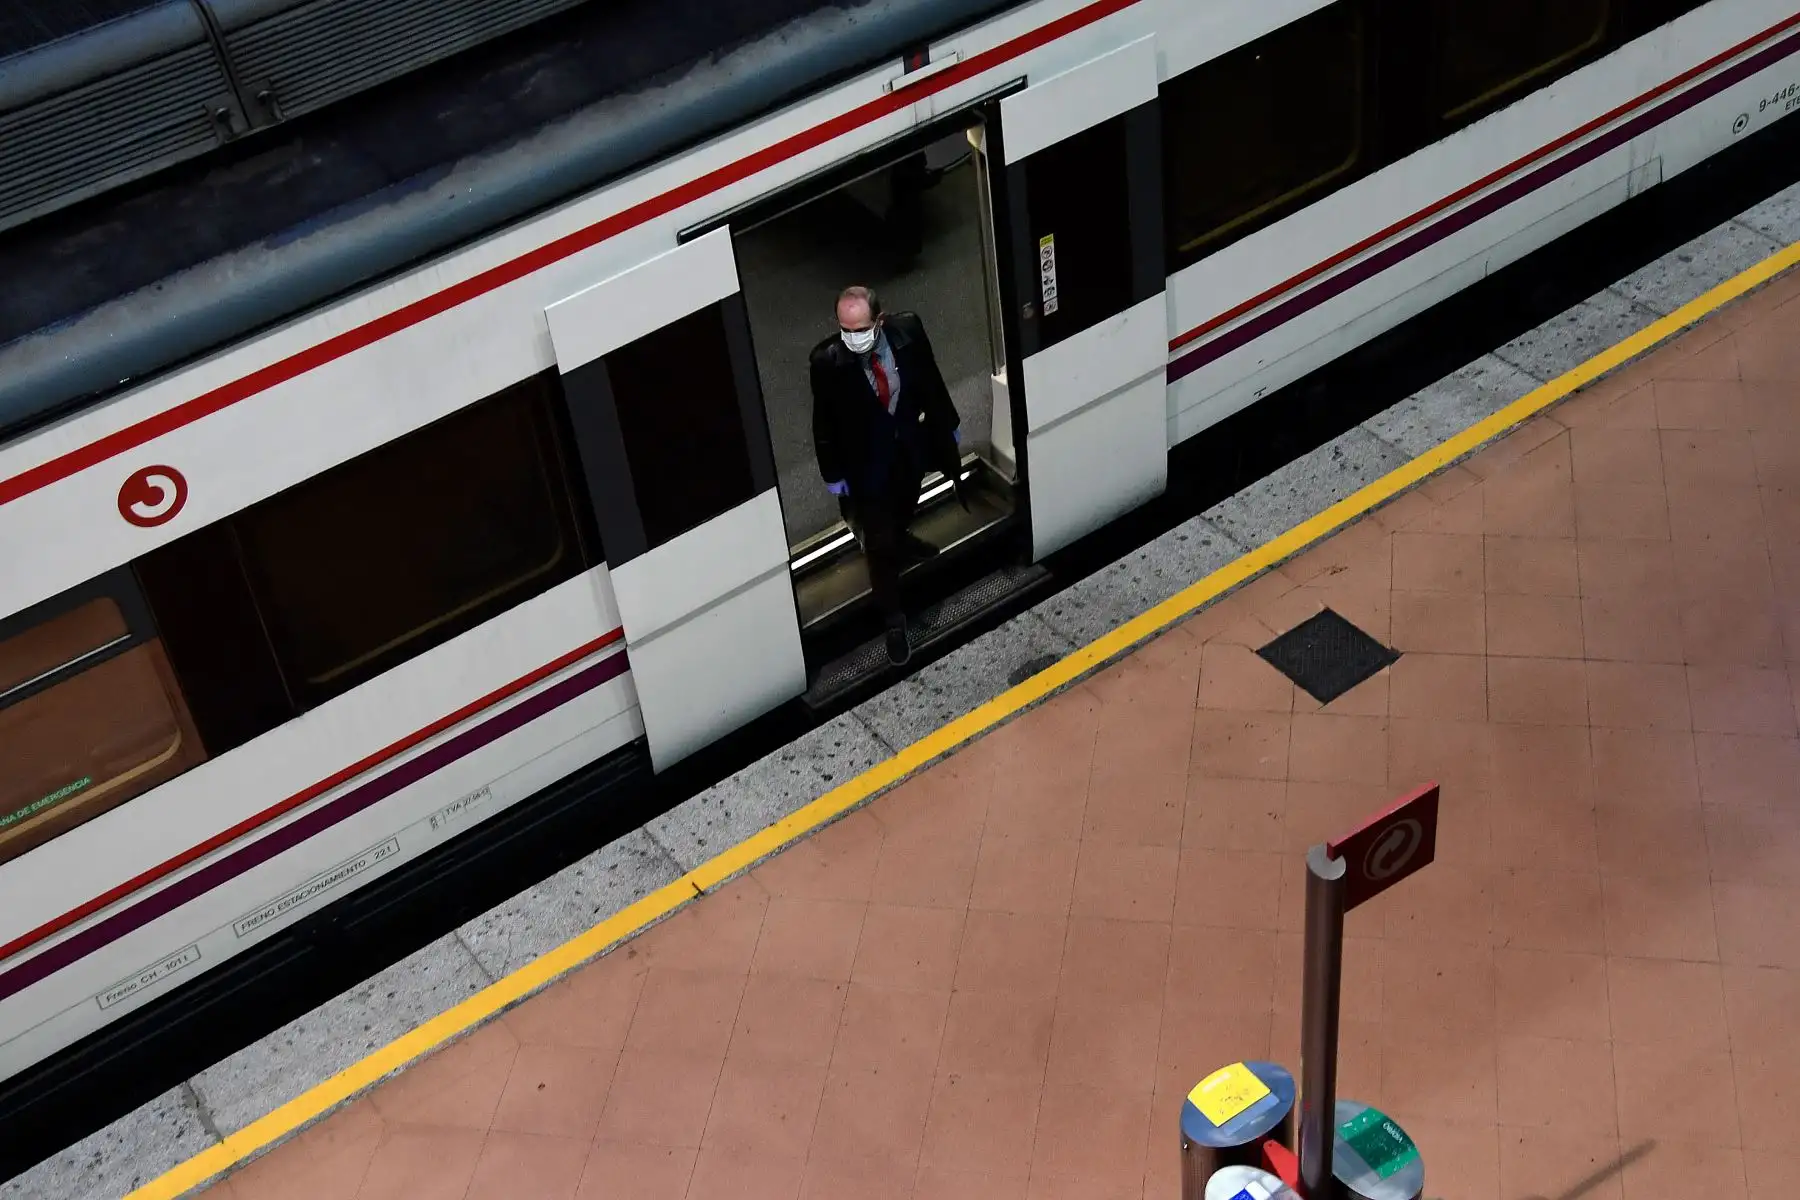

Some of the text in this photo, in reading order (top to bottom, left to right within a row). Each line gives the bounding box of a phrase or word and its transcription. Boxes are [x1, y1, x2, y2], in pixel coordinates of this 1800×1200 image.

[31, 777, 90, 810] EMERGENCIA
[241, 909, 276, 932] FRENO
[277, 859, 367, 913] ESTACIONAMIENTO
[106, 984, 137, 1002] Freno
[140, 969, 158, 984] CH
